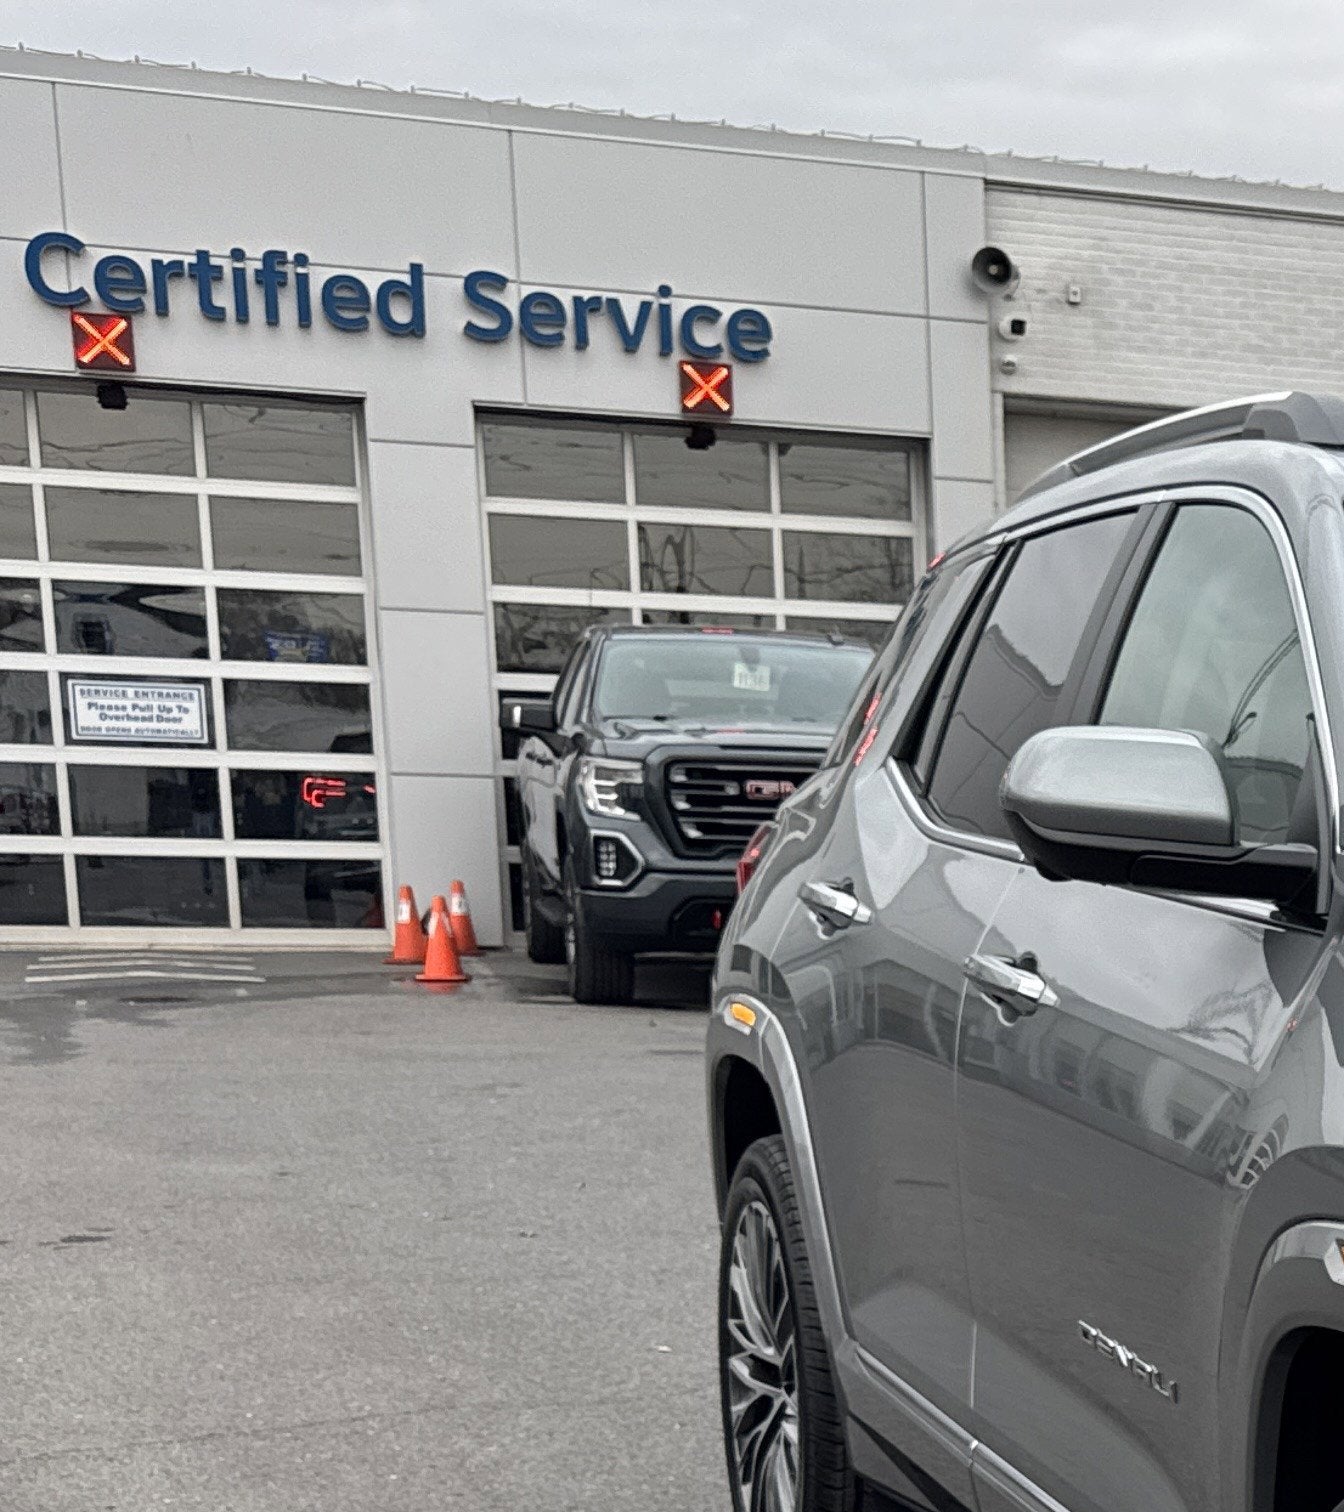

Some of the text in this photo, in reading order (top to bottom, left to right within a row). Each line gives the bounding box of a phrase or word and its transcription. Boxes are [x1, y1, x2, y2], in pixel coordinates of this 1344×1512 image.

[24, 231, 773, 362] Certified Service
[80, 688, 194, 701] SERVICE ENTRANCE
[87, 702, 127, 712] Please
[131, 703, 153, 713] Pull
[158, 704, 173, 714] Up
[99, 712, 153, 722] Overhead
